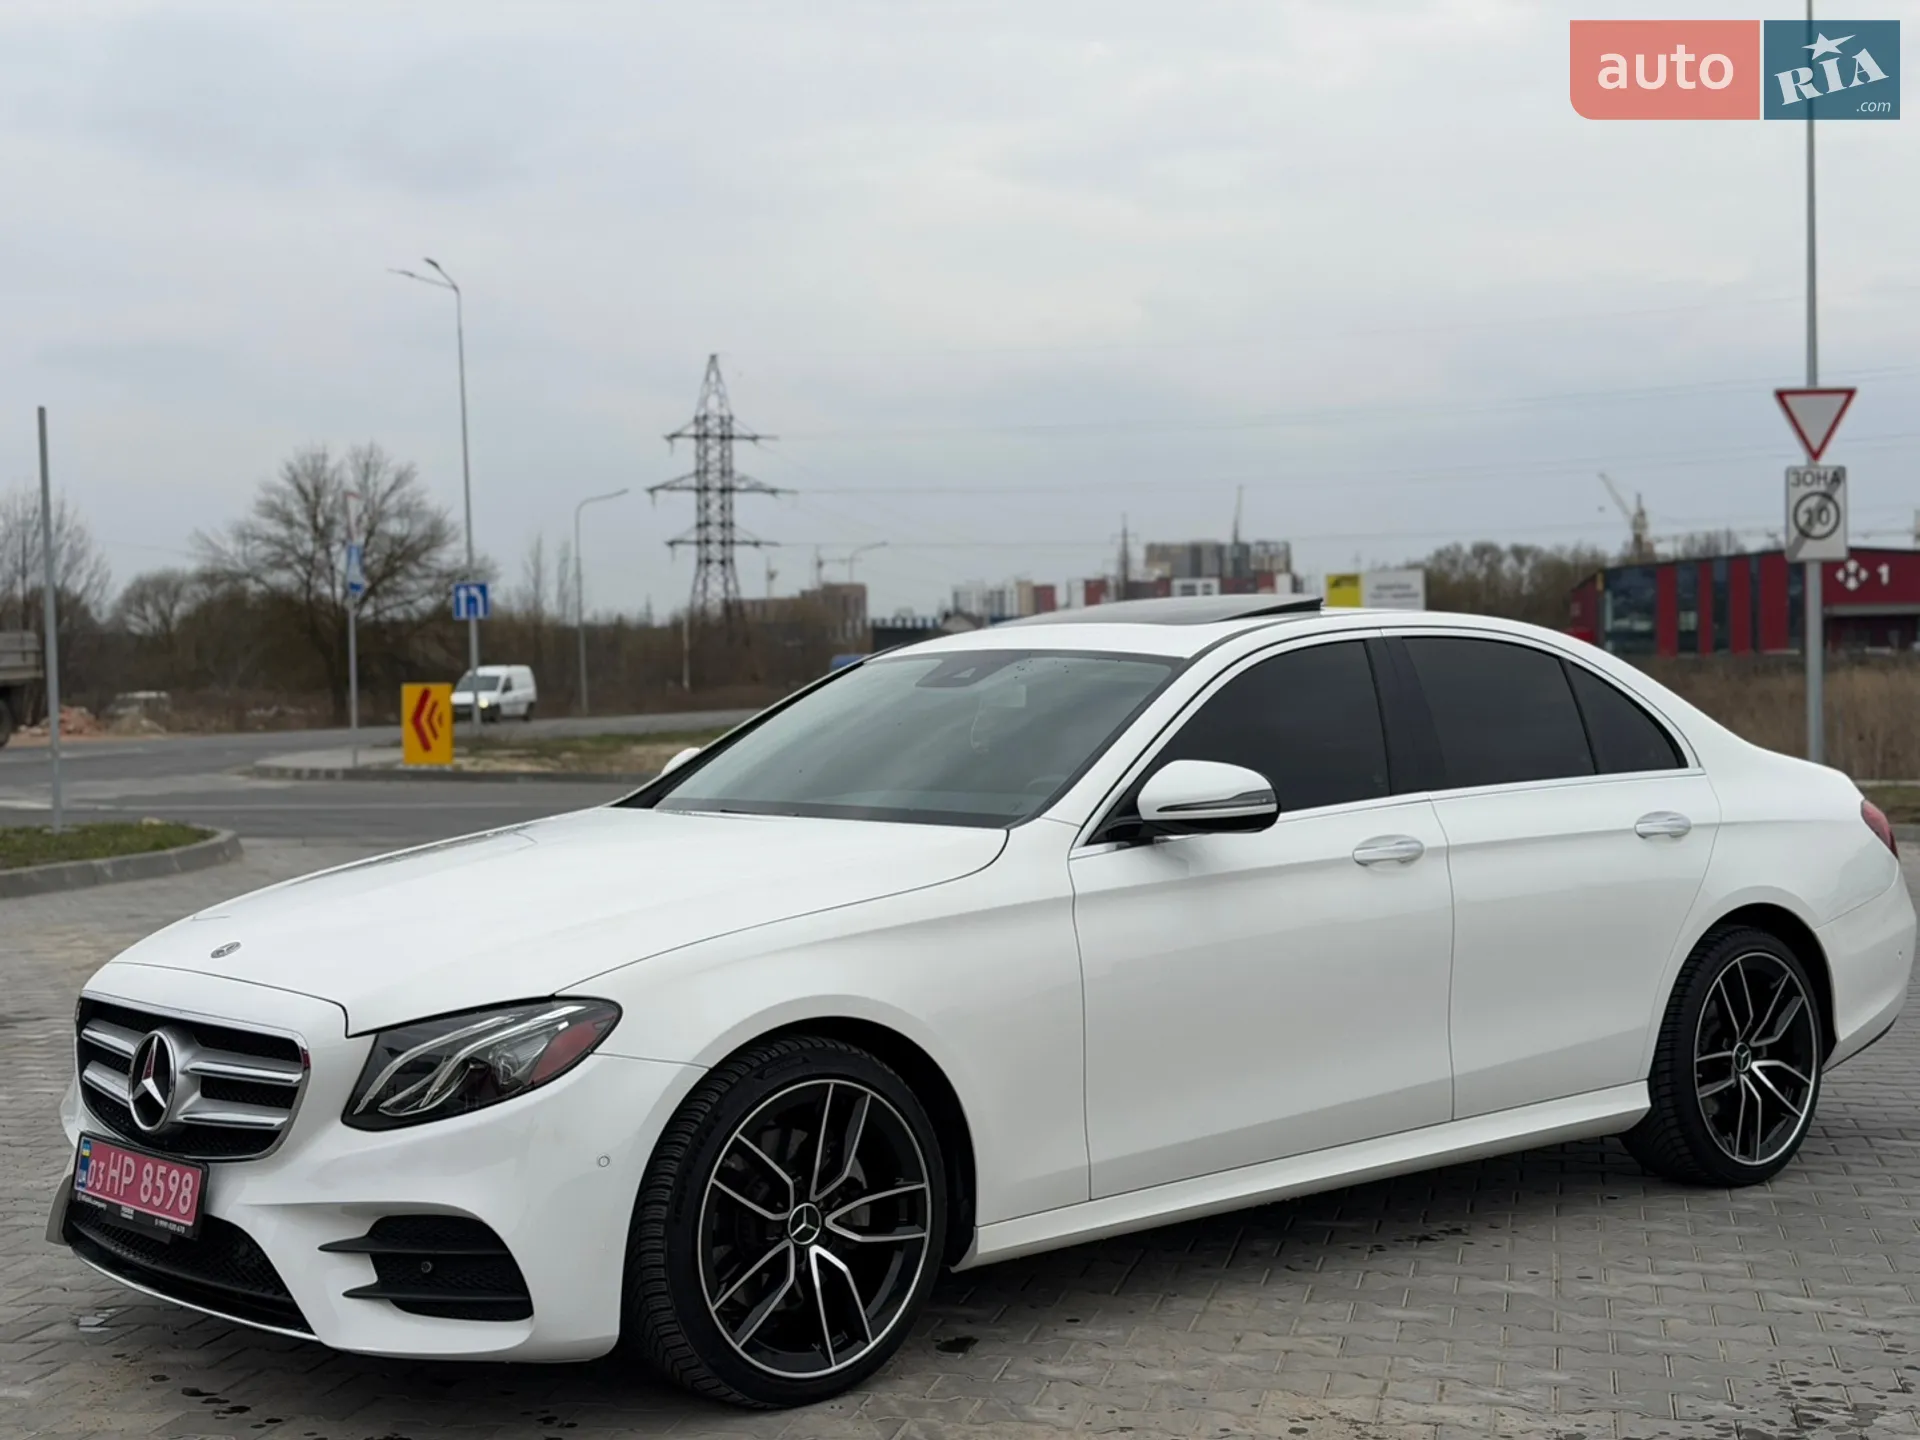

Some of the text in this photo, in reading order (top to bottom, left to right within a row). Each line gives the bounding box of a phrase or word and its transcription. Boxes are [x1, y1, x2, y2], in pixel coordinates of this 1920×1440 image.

[1791, 470, 1842, 488] ЗОНА
[1877, 563, 1890, 586] 1
[140, 1162, 193, 1215] 8598
